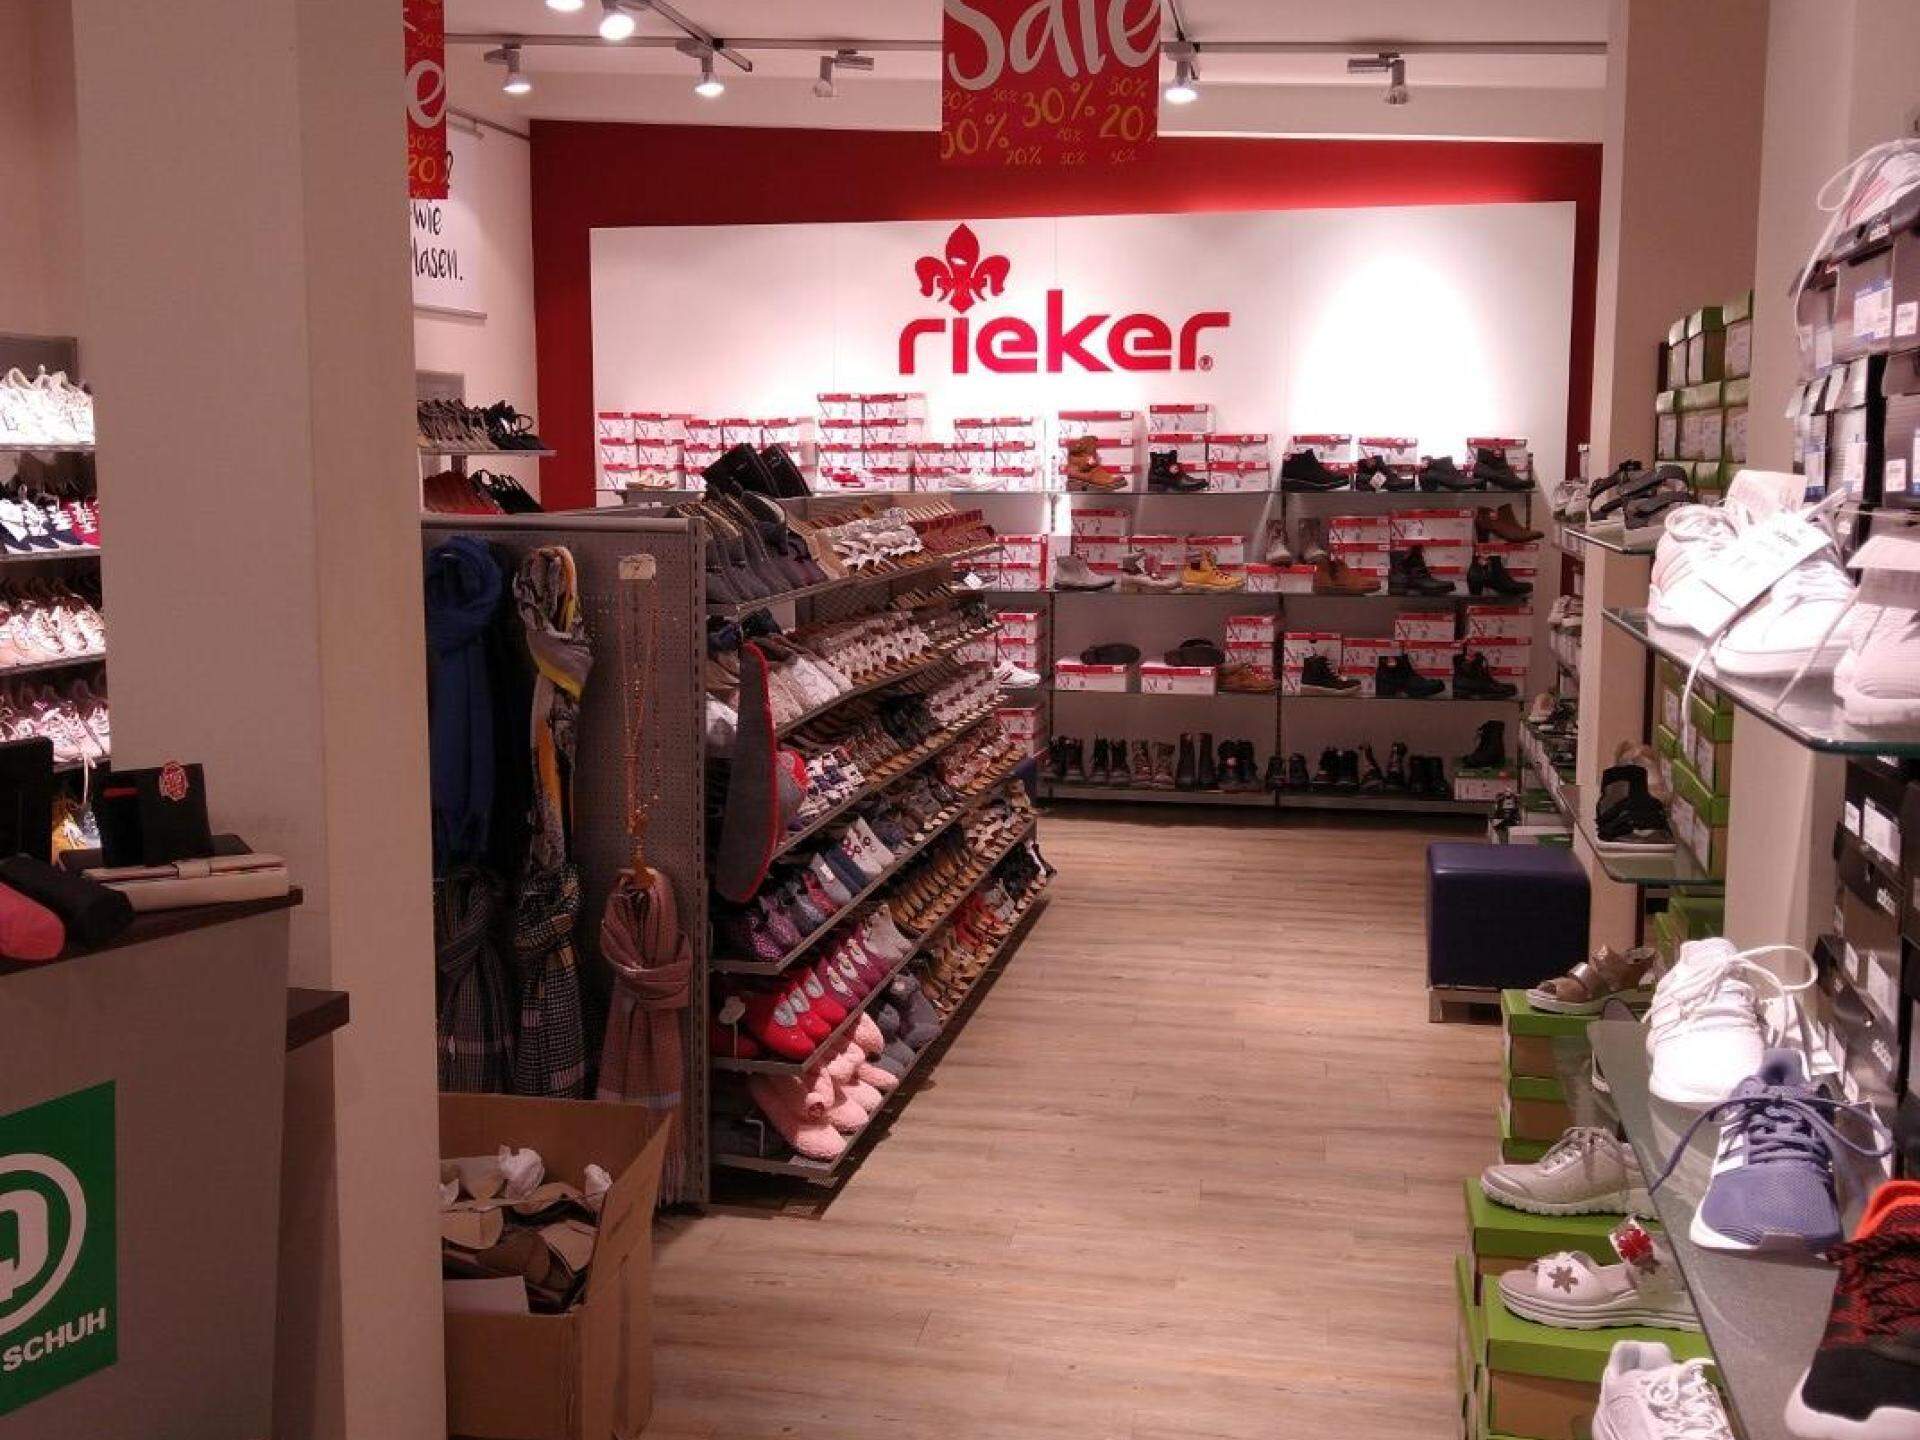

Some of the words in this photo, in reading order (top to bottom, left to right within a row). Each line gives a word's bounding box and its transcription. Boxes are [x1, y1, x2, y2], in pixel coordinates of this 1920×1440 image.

[944, 0, 1161, 90] Sale
[1021, 80, 1095, 128] 30%
[1098, 104, 1156, 143] 20
[3, 1306, 107, 1372] SCHUH
